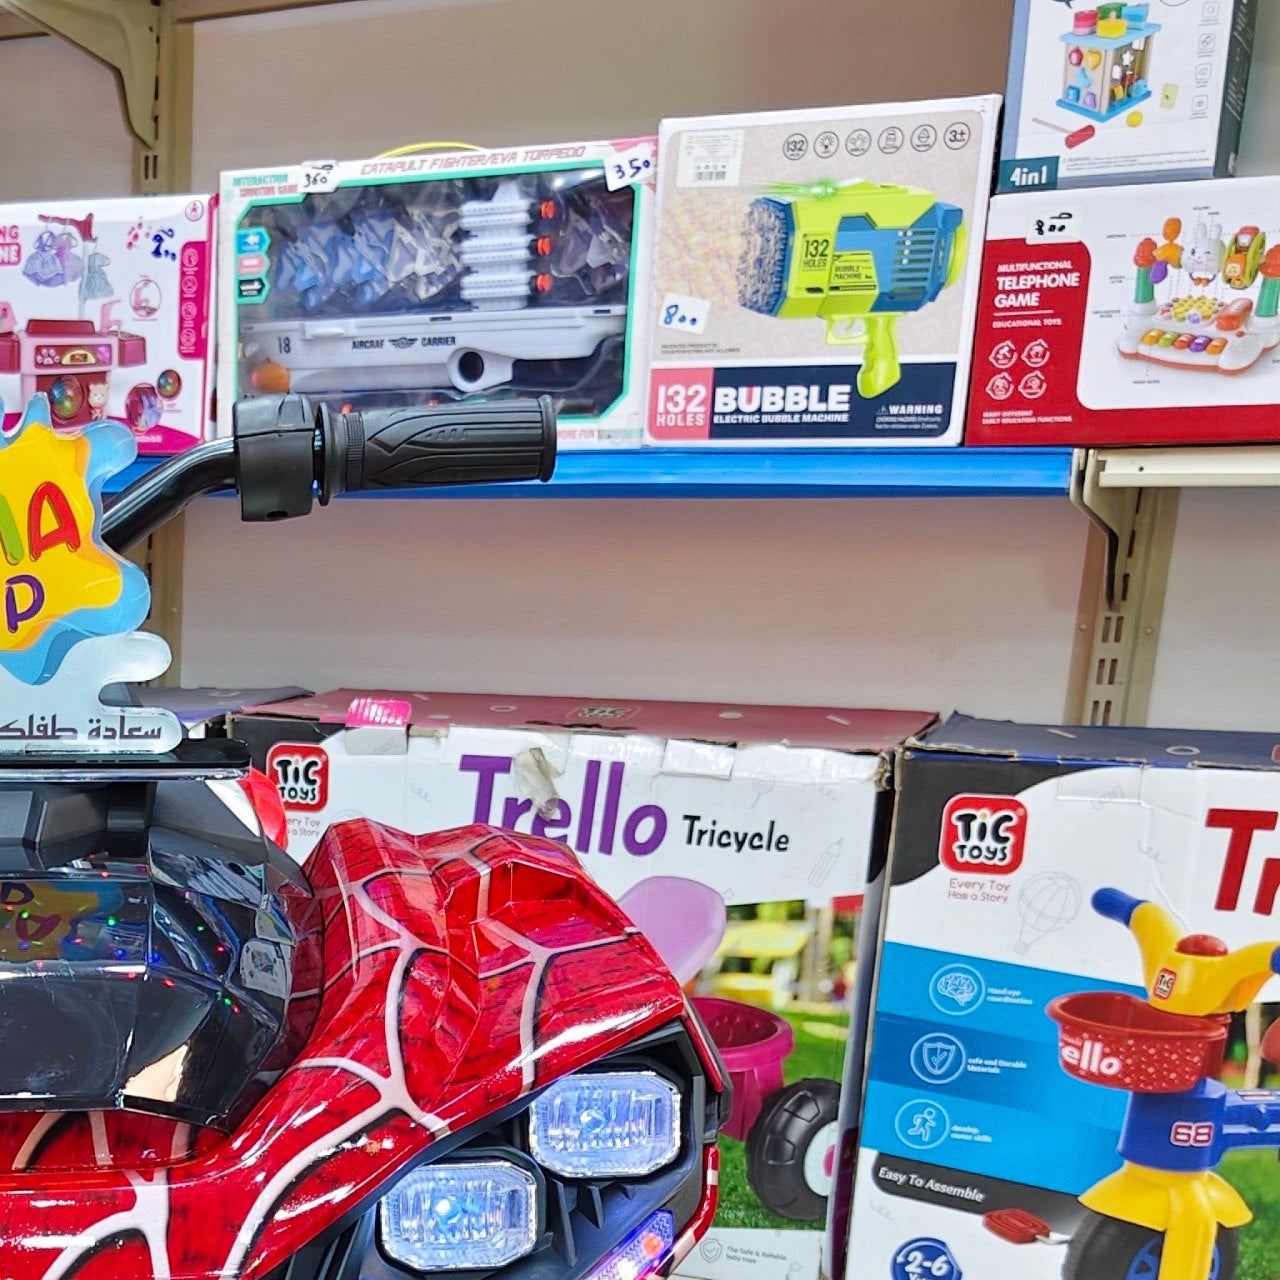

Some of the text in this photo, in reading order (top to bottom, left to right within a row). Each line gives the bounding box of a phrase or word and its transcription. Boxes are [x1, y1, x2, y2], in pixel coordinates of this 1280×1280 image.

[785, 139, 804, 153] 132
[360, 160, 428, 175] CATAPULT
[522, 147, 586, 162] TORPEDO
[614, 157, 651, 179] 350
[1010, 165, 1047, 186] 4in1
[805, 239, 829, 258] 132
[803, 258, 827, 268] HOLES
[996, 273, 1080, 290] TELEPHONE
[994, 293, 1040, 308] GAME
[992, 318, 1062, 328] EDUCATIONAL TOYS
[277, 336, 291, 354] 18
[421, 336, 456, 347] CARRIER
[657, 384, 707, 414] 132
[713, 384, 851, 414] BUBBLE
[713, 412, 849, 424] ELECTRIC BUBBLE MACHINE
[888, 404, 943, 415] WARNING
[656, 413, 705, 427] HOLES
[87, 714, 163, 741] سعادة
[279, 786, 316, 802] TOYS
[459, 754, 790, 857] Trello Tricycle
[304, 817, 320, 828] Toy
[956, 845, 1007, 862] TOYS
[949, 878, 1011, 894] Every Toy
[948, 890, 1008, 903] Has a Story
[1172, 1122, 1214, 1147] 68
[878, 1166, 985, 1203] Easy To Assemble
[740, 1248, 754, 1256] Safe
[905, 1251, 950, 1277] 2-6
